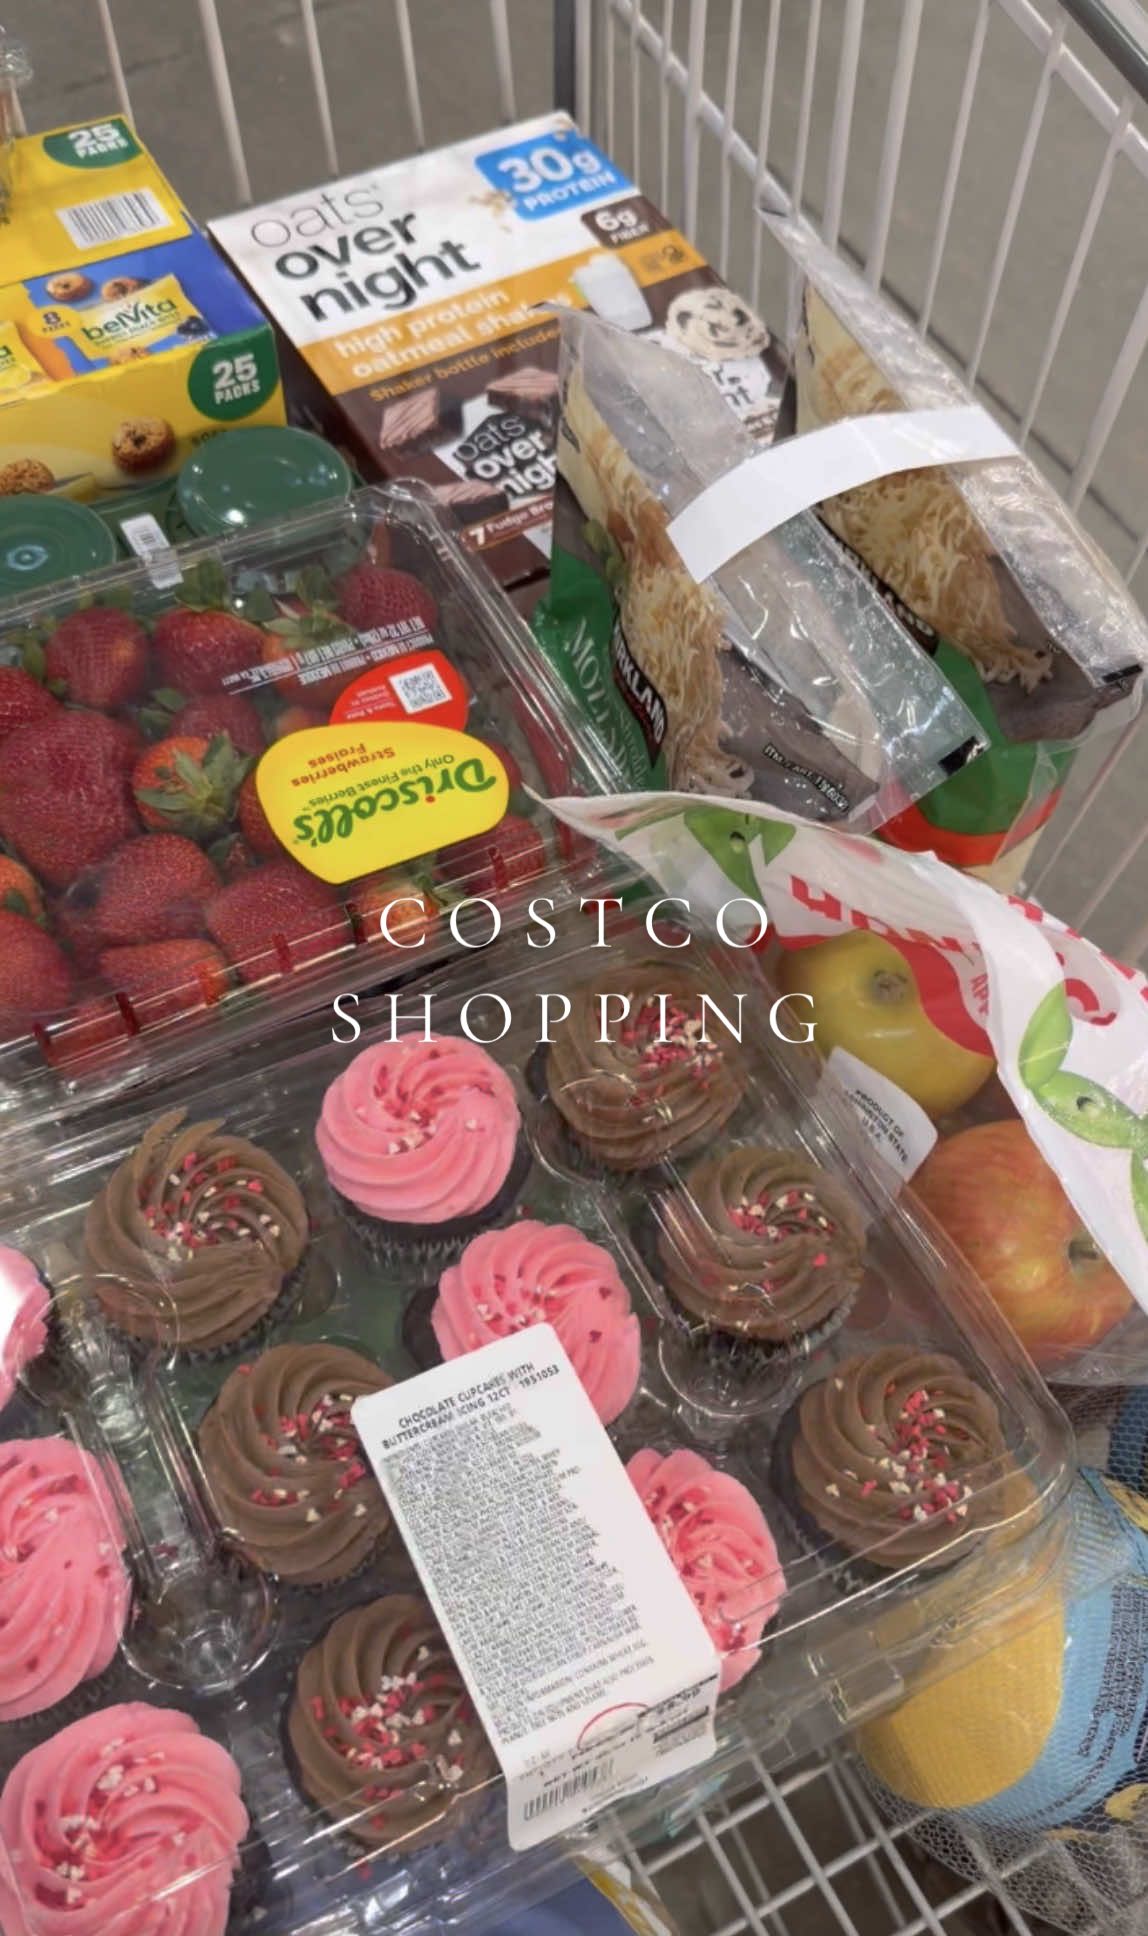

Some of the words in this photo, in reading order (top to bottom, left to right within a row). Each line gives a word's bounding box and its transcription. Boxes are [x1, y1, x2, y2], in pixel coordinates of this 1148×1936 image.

[69, 123, 120, 144] 25
[74, 138, 129, 159] PACKS
[498, 147, 602, 192] 30g
[523, 170, 617, 211] PROTEIN
[251, 188, 383, 248] oats
[595, 208, 638, 232] 6g
[610, 223, 650, 244] FIBER
[275, 211, 416, 279] over
[300, 240, 481, 321] night
[82, 299, 176, 341] belVita
[334, 325, 403, 358] high
[407, 288, 509, 338] protein
[212, 353, 258, 390] 25
[352, 326, 472, 378] oatmeal
[214, 379, 261, 405] PACKS
[368, 371, 433, 402] Shaker
[436, 352, 490, 379] bottle
[455, 415, 525, 461] oats
[474, 430, 547, 478] over
[469, 527, 486, 546] 7
[291, 747, 396, 787] Strawberries
[307, 743, 367, 768] Fraises
[400, 763, 424, 777] the
[425, 754, 455, 769] Only
[293, 758, 496, 847] Driscoll's
[358, 772, 400, 792] Finest
[399, 1396, 456, 1429] CHOCOLATE
[457, 1373, 507, 1403] CUPCAKES
[507, 1362, 535, 1382] WITH
[382, 1411, 455, 1449] BUTTERCREAM
[457, 1398, 486, 1417] ICING
[488, 1387, 511, 1403] 12CT
